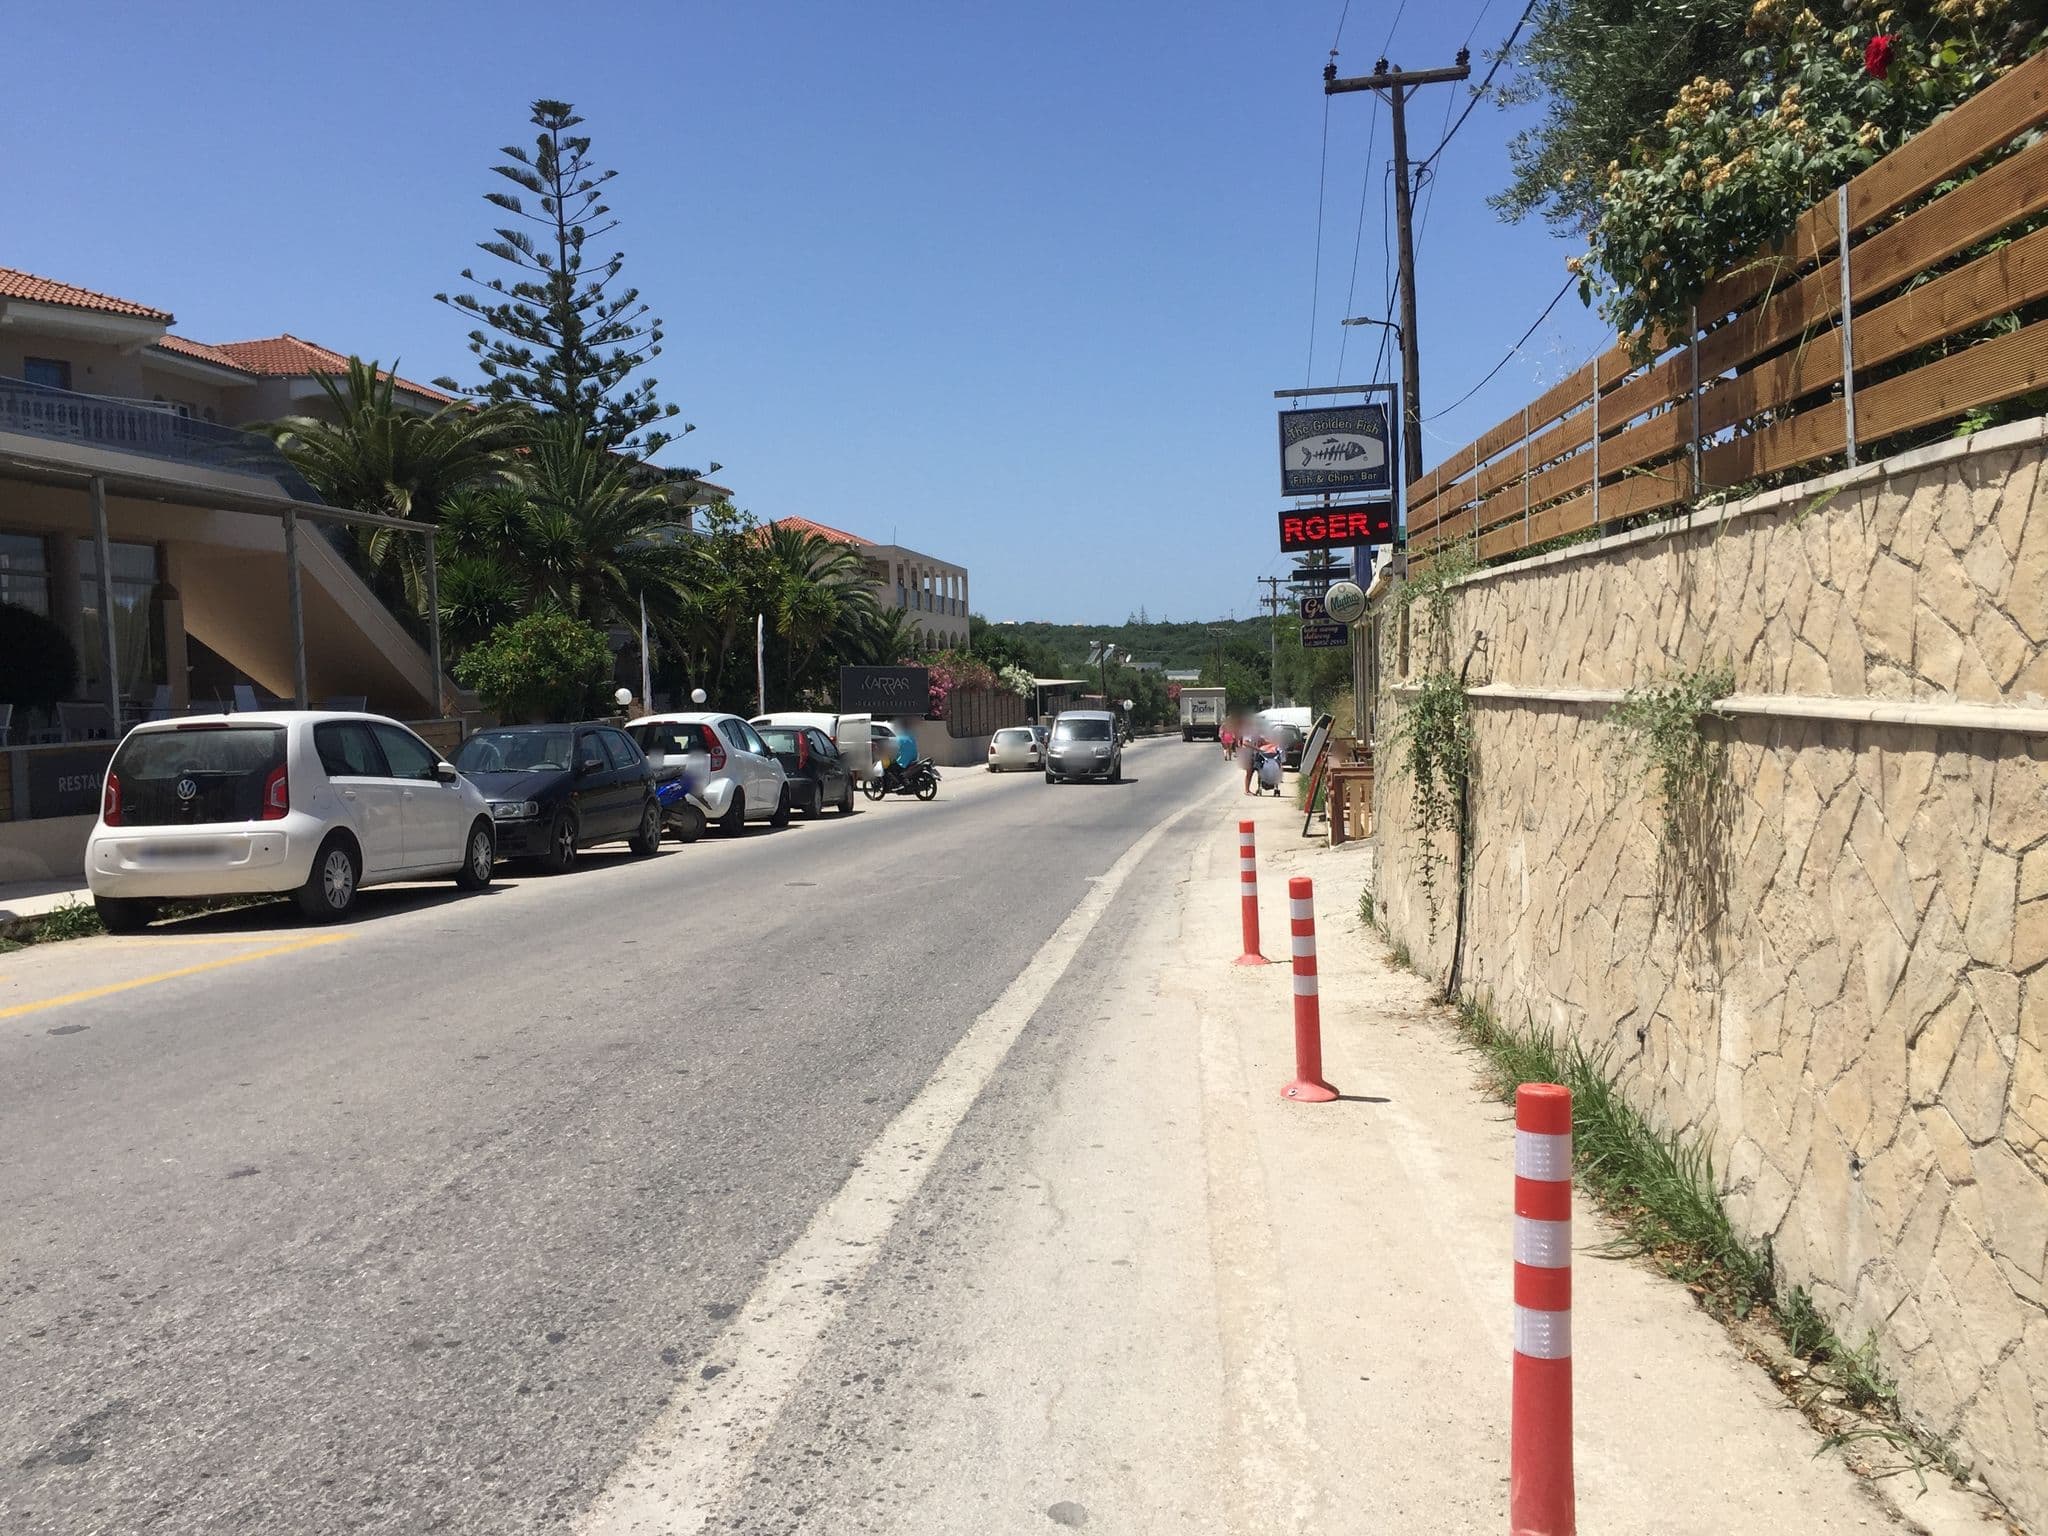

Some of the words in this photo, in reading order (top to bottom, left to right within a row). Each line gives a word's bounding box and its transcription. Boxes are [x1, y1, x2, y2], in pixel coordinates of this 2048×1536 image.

[1287, 426, 1309, 440] The
[1313, 418, 1352, 431] Golden
[1356, 419, 1379, 435] Fish
[1293, 476, 1312, 485] Fish
[1316, 474, 1324, 483] &
[1327, 473, 1354, 484] Chips
[1361, 471, 1377, 481] Bar
[1284, 512, 1370, 543] RGER
[861, 675, 910, 695] KARRAS
